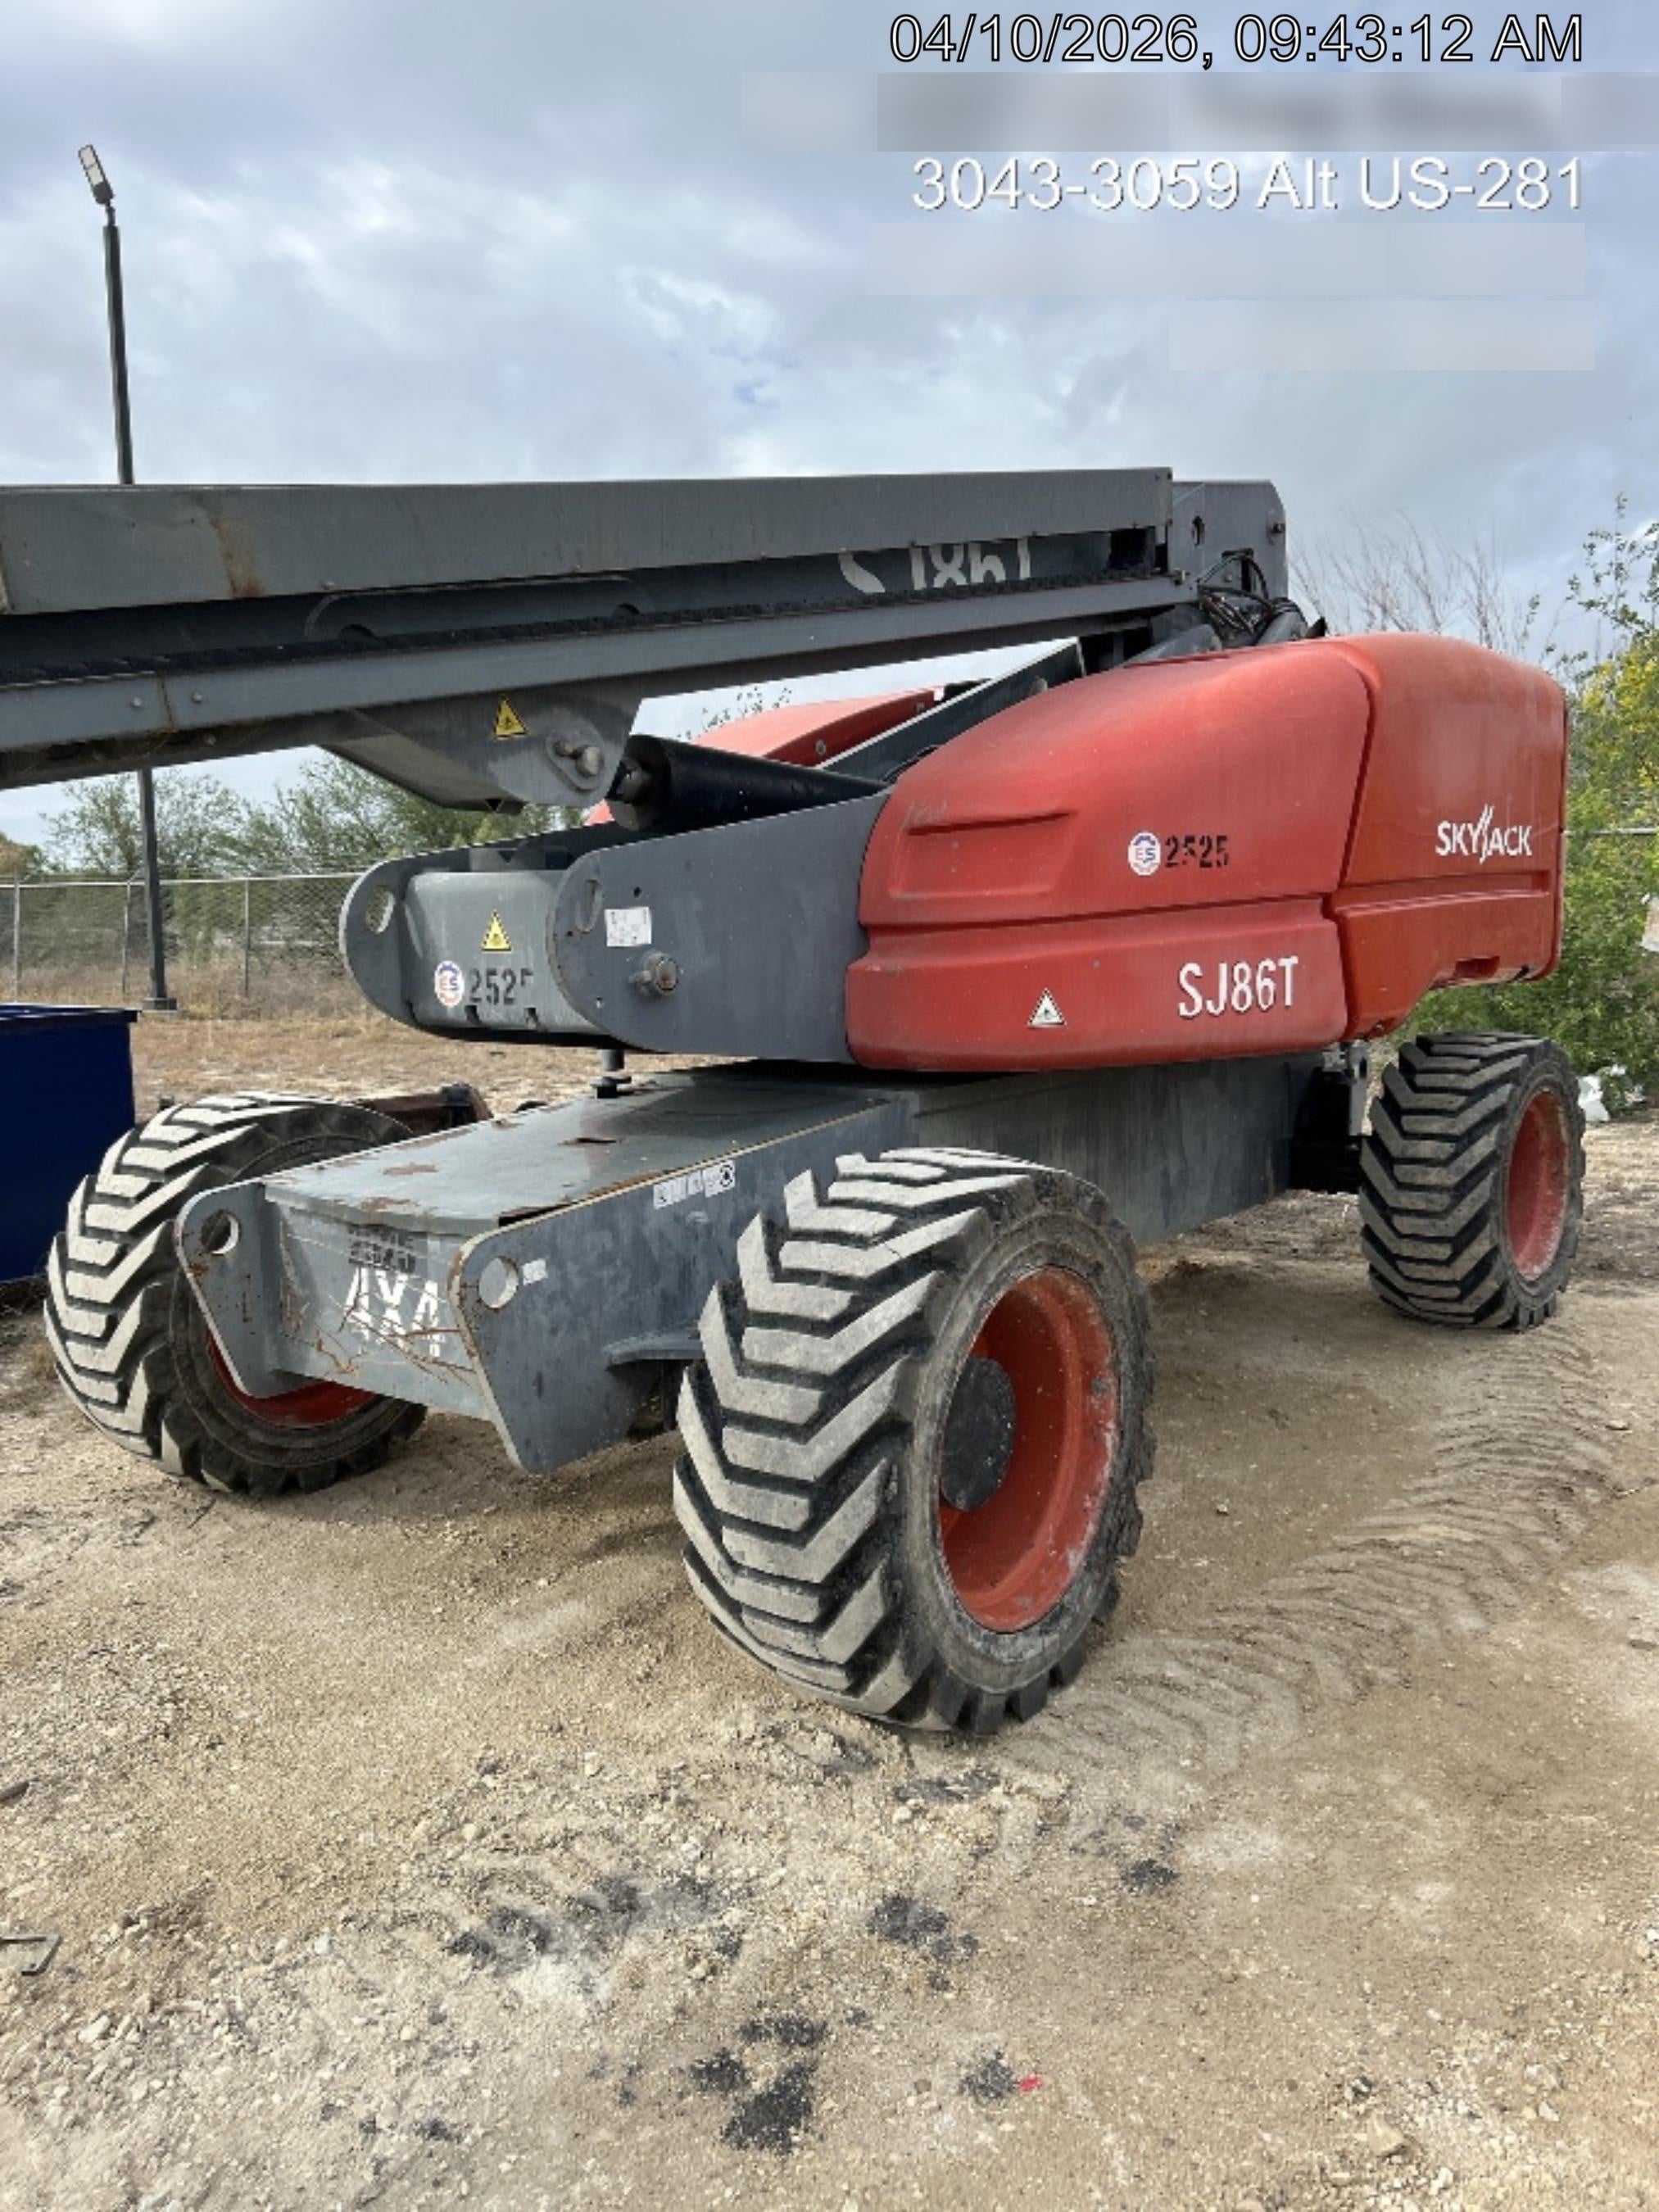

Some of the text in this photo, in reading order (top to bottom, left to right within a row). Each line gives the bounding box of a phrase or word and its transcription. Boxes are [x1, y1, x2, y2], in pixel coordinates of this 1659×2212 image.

[1165, 835, 1229, 868] 2525
[1435, 804, 1533, 865] SKYJACK
[1178, 955, 1299, 1018] SJ86T
